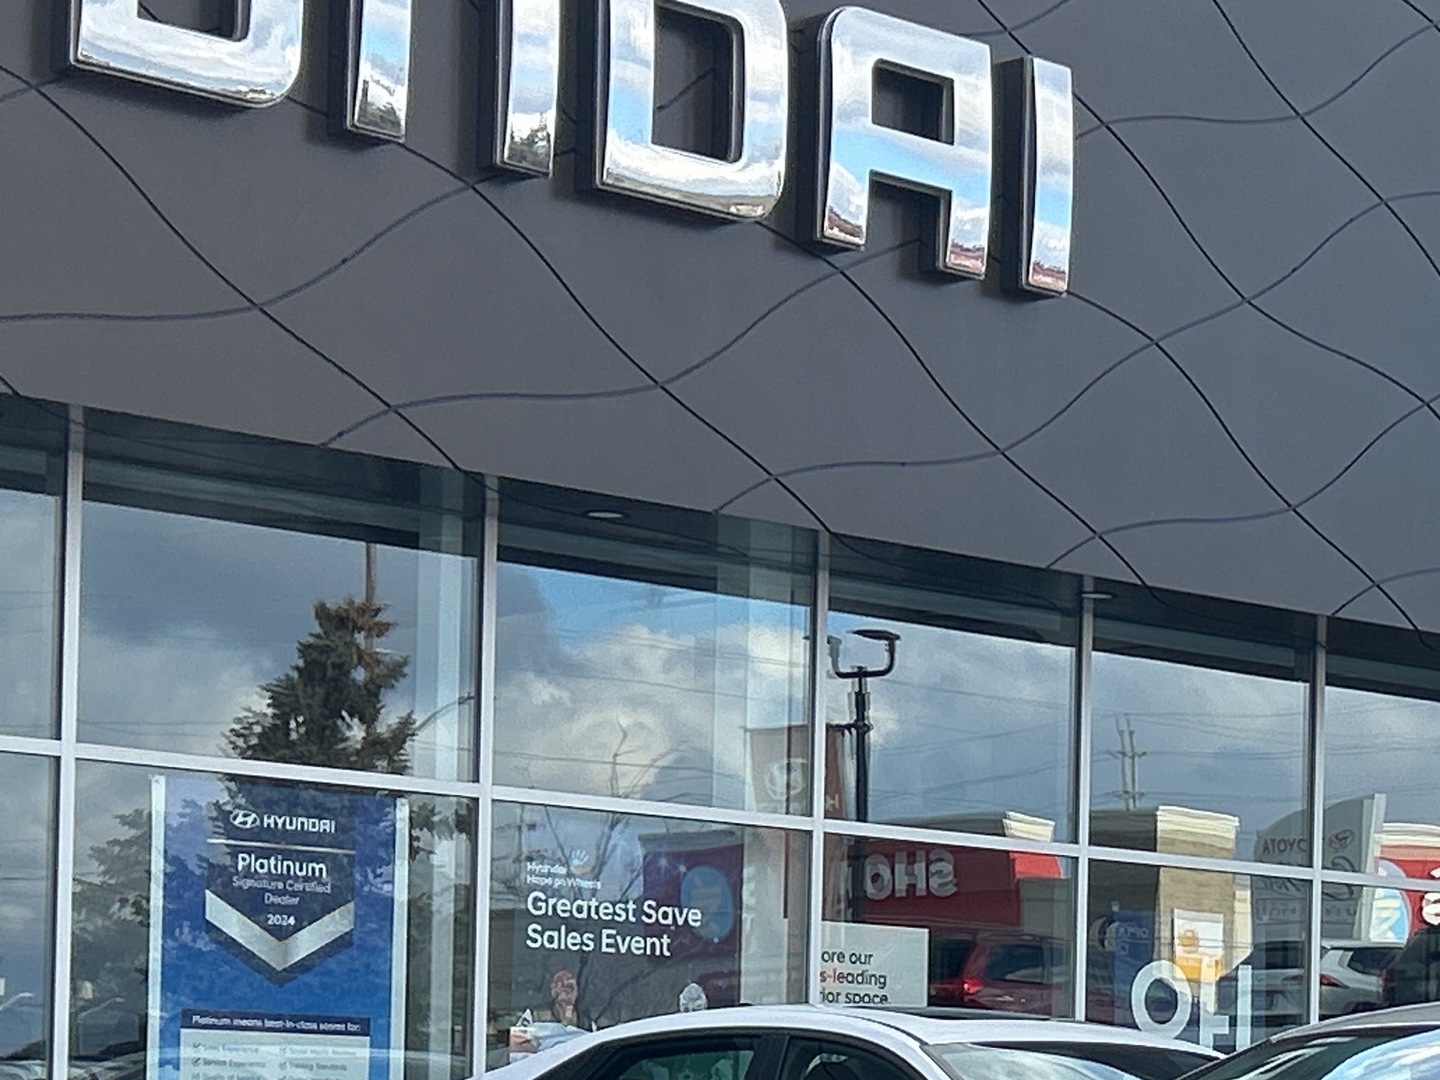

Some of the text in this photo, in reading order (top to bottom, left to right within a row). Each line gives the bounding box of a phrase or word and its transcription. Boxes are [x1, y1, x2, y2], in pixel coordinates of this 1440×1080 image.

[263, 814, 336, 833] HYUNDAI
[237, 853, 328, 879] Platinum
[526, 890, 703, 928] Greatest Save
[526, 923, 672, 957] Sales Event
[821, 951, 874, 965] ore our
[820, 967, 888, 989] s-leading
